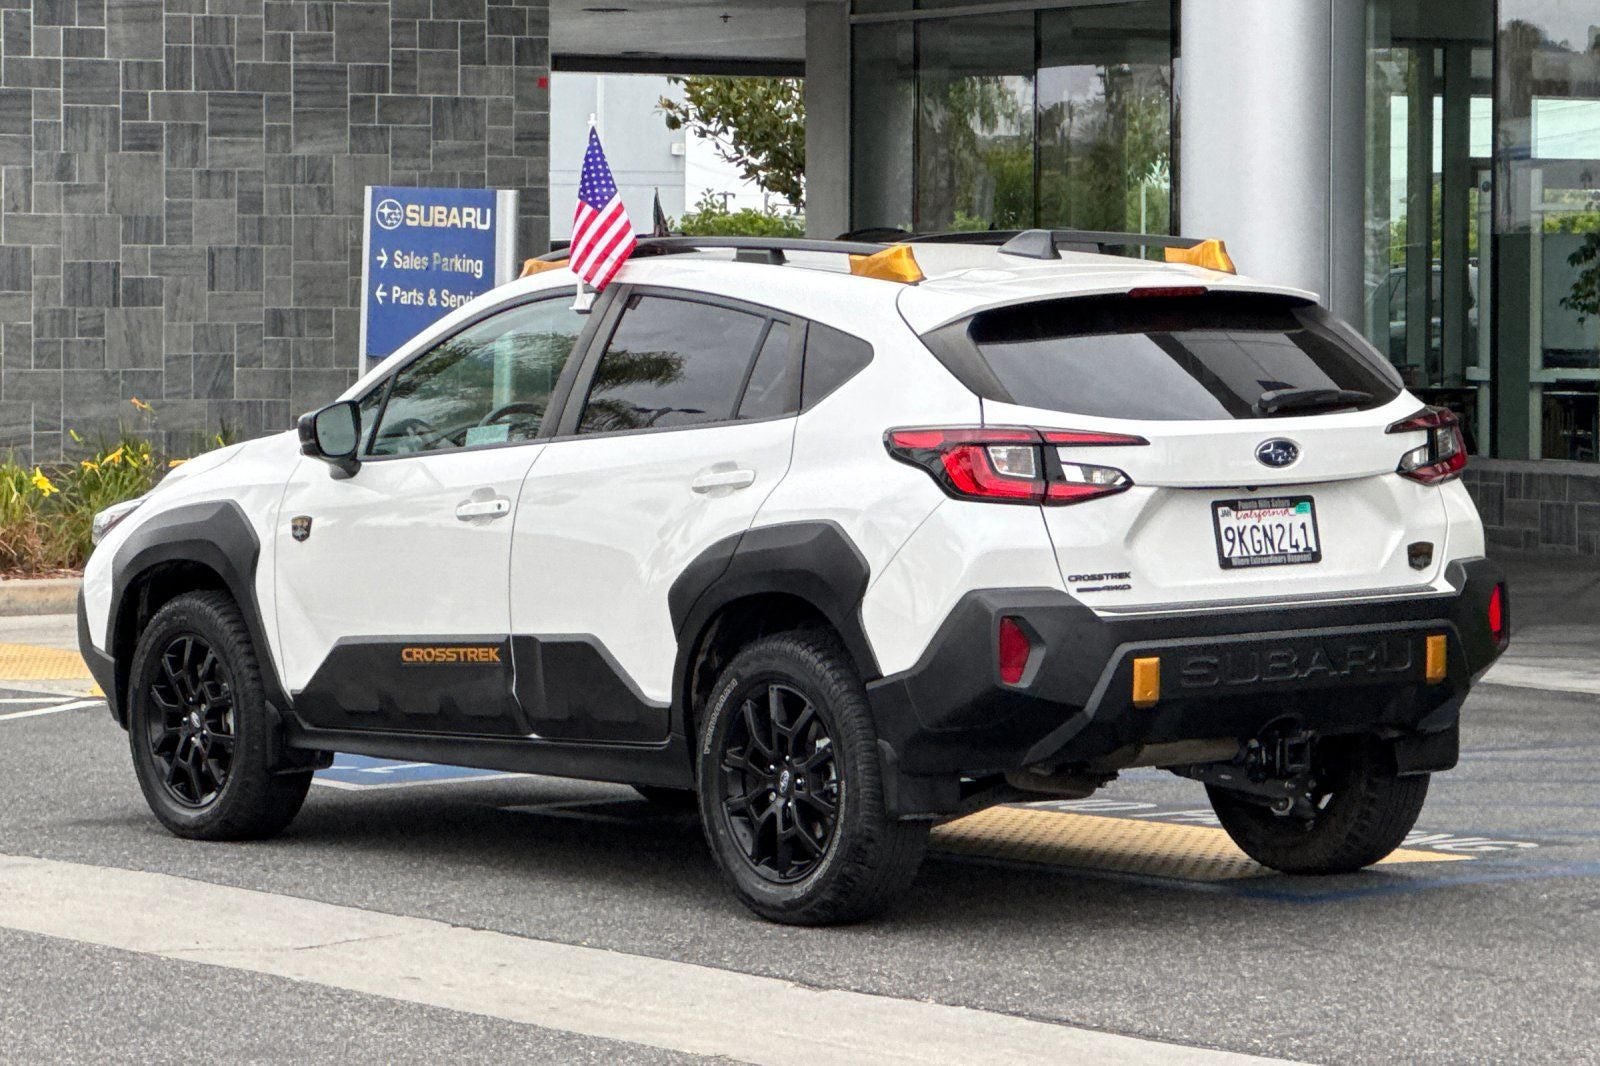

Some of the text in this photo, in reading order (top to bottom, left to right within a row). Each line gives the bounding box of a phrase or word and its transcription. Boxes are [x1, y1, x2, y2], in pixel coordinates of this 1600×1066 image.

[406, 204, 491, 230] SUBARU
[393, 250, 483, 279] Sales Parking
[391, 286, 478, 308] Parts & Serv
[1235, 508, 1296, 523] California
[1224, 522, 1313, 556] 9KGN241
[1067, 571, 1131, 582] CROSSTREK
[401, 647, 500, 662] CROSSTREK
[1180, 639, 1413, 688] SUBARU
